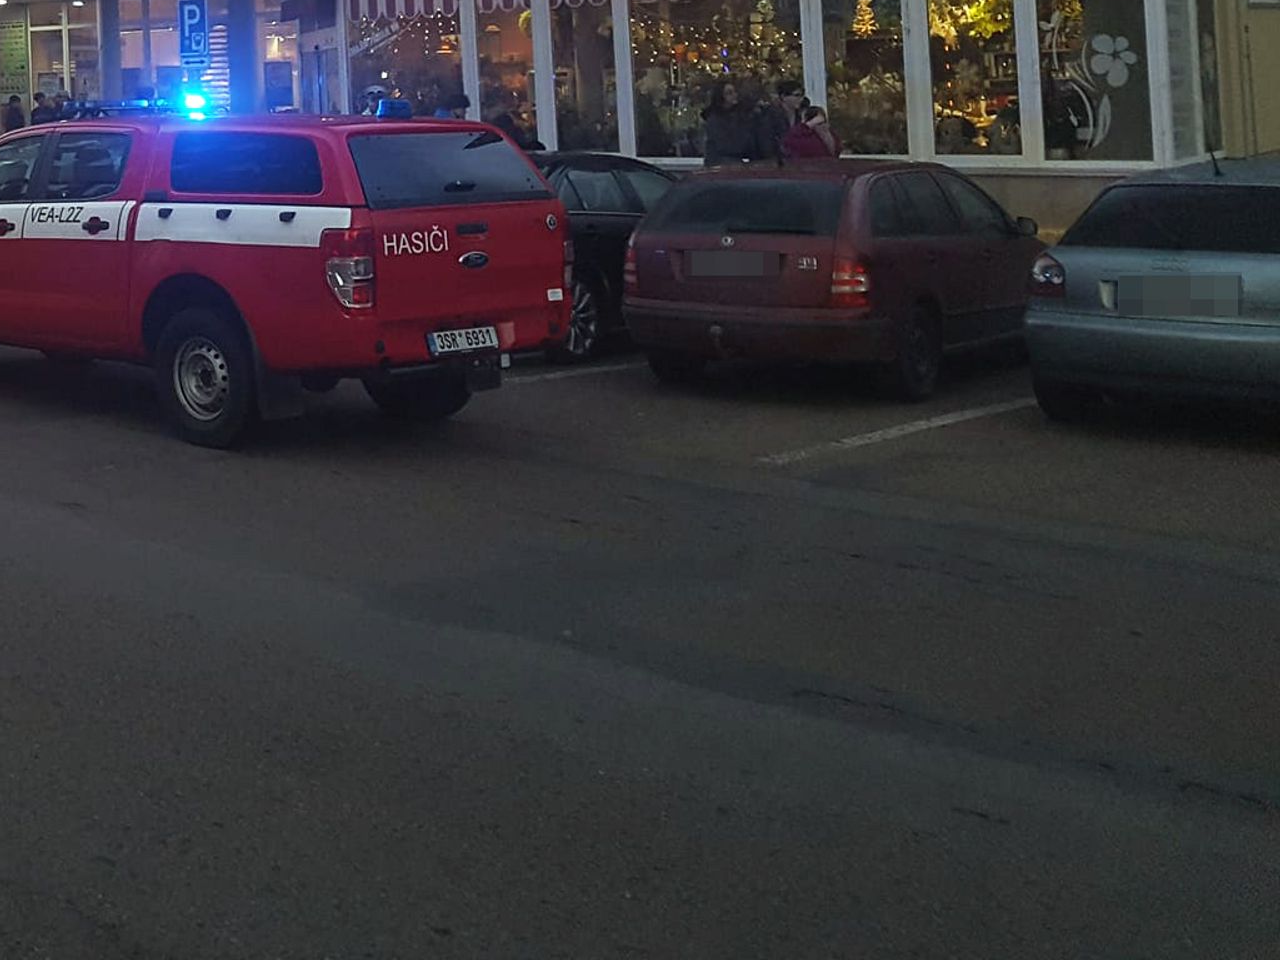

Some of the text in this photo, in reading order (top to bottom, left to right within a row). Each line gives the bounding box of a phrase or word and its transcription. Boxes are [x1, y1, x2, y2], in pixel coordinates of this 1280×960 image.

[183, 5, 200, 37] P
[31, 206, 84, 224] VEA-L2Z
[383, 225, 449, 256] HASIČI
[436, 328, 494, 350] 3SR 6931
